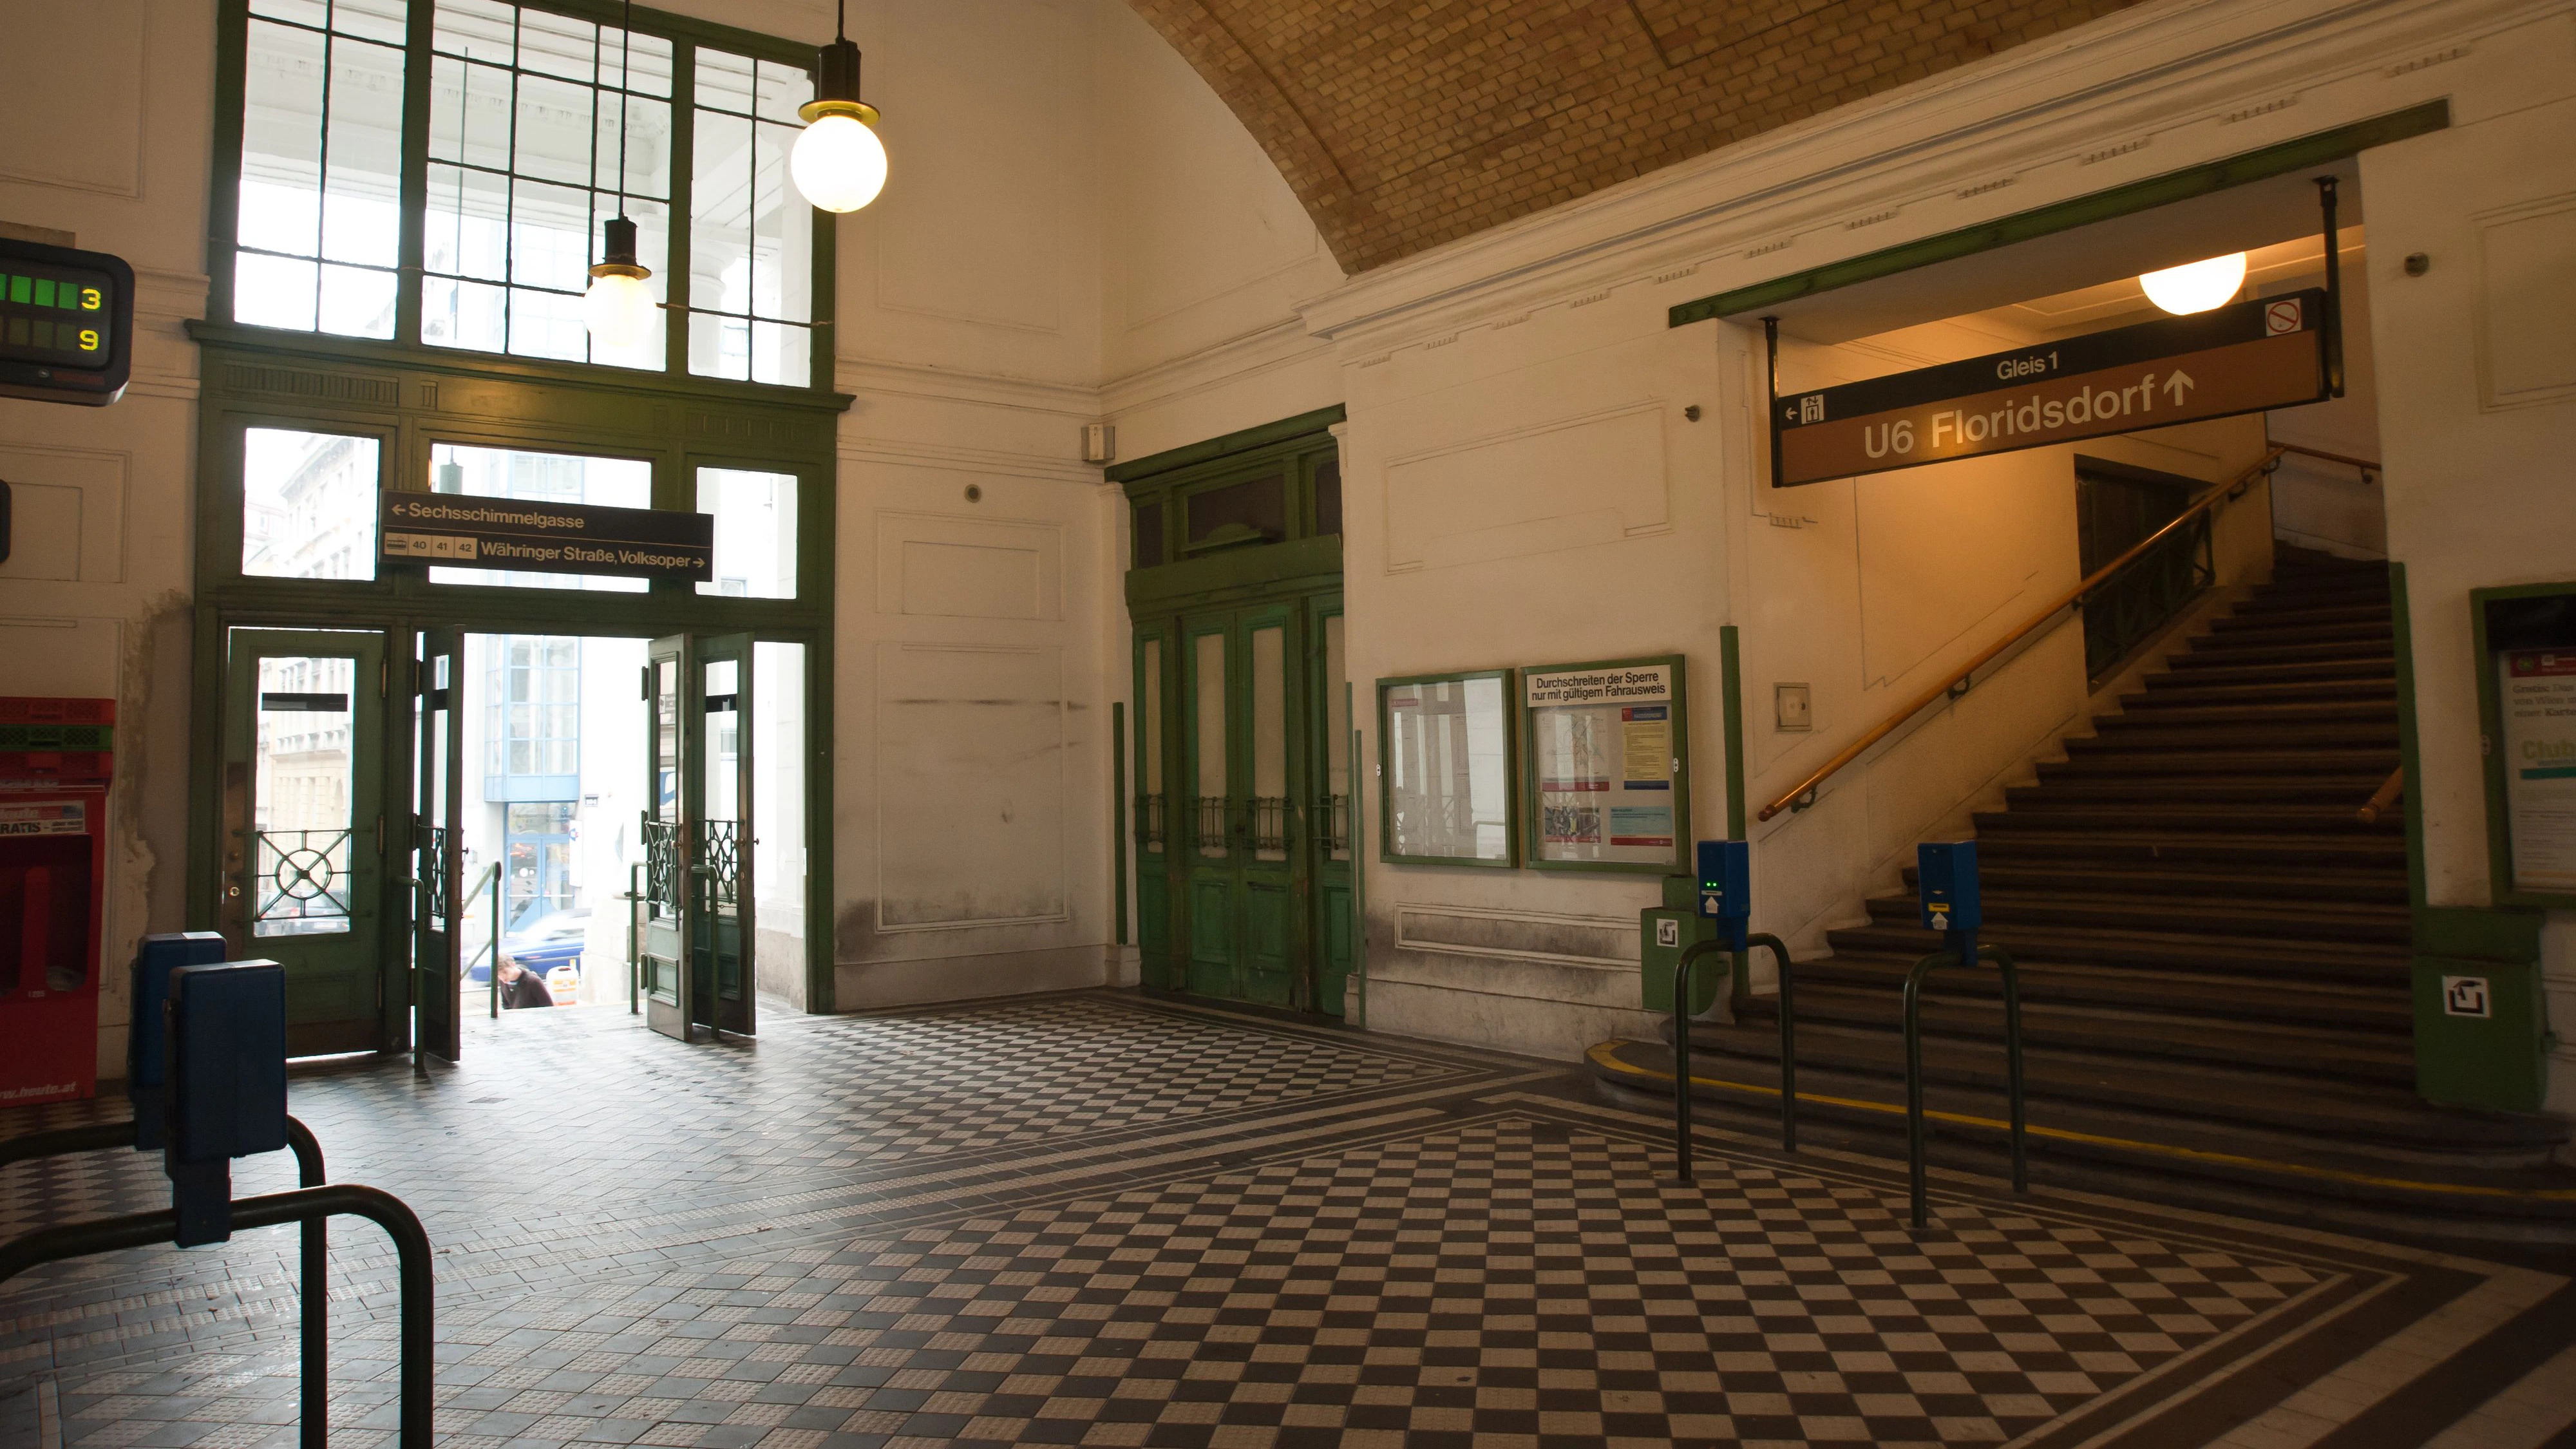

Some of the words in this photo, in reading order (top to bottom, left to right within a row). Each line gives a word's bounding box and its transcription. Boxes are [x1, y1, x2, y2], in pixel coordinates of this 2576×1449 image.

[82, 289, 101, 310] 3
[80, 330, 98, 350] 9
[1996, 356, 2045, 381] Gleis
[2049, 351, 2058, 370] 1
[1864, 420, 1915, 459] U6
[1932, 374, 2155, 448] Floridsdorf
[408, 502, 584, 529] Sechsschimmelgasse
[413, 541, 426, 550] 40
[437, 542, 448, 551] 41
[459, 544, 472, 553] 42
[481, 541, 561, 561] Währinger
[564, 546, 617, 565] Straße,
[618, 550, 691, 569] Volksoper
[1537, 675, 1605, 688] Durchschreiten
[1607, 674, 1623, 685] der
[1625, 672, 1659, 685] Sperre
[1532, 691, 1546, 701] nur
[1548, 688, 1562, 700] mit
[1563, 687, 1604, 701] gültigem
[1605, 682, 1666, 697] Fahrausweis
[0, 822, 41, 835] RATIS
